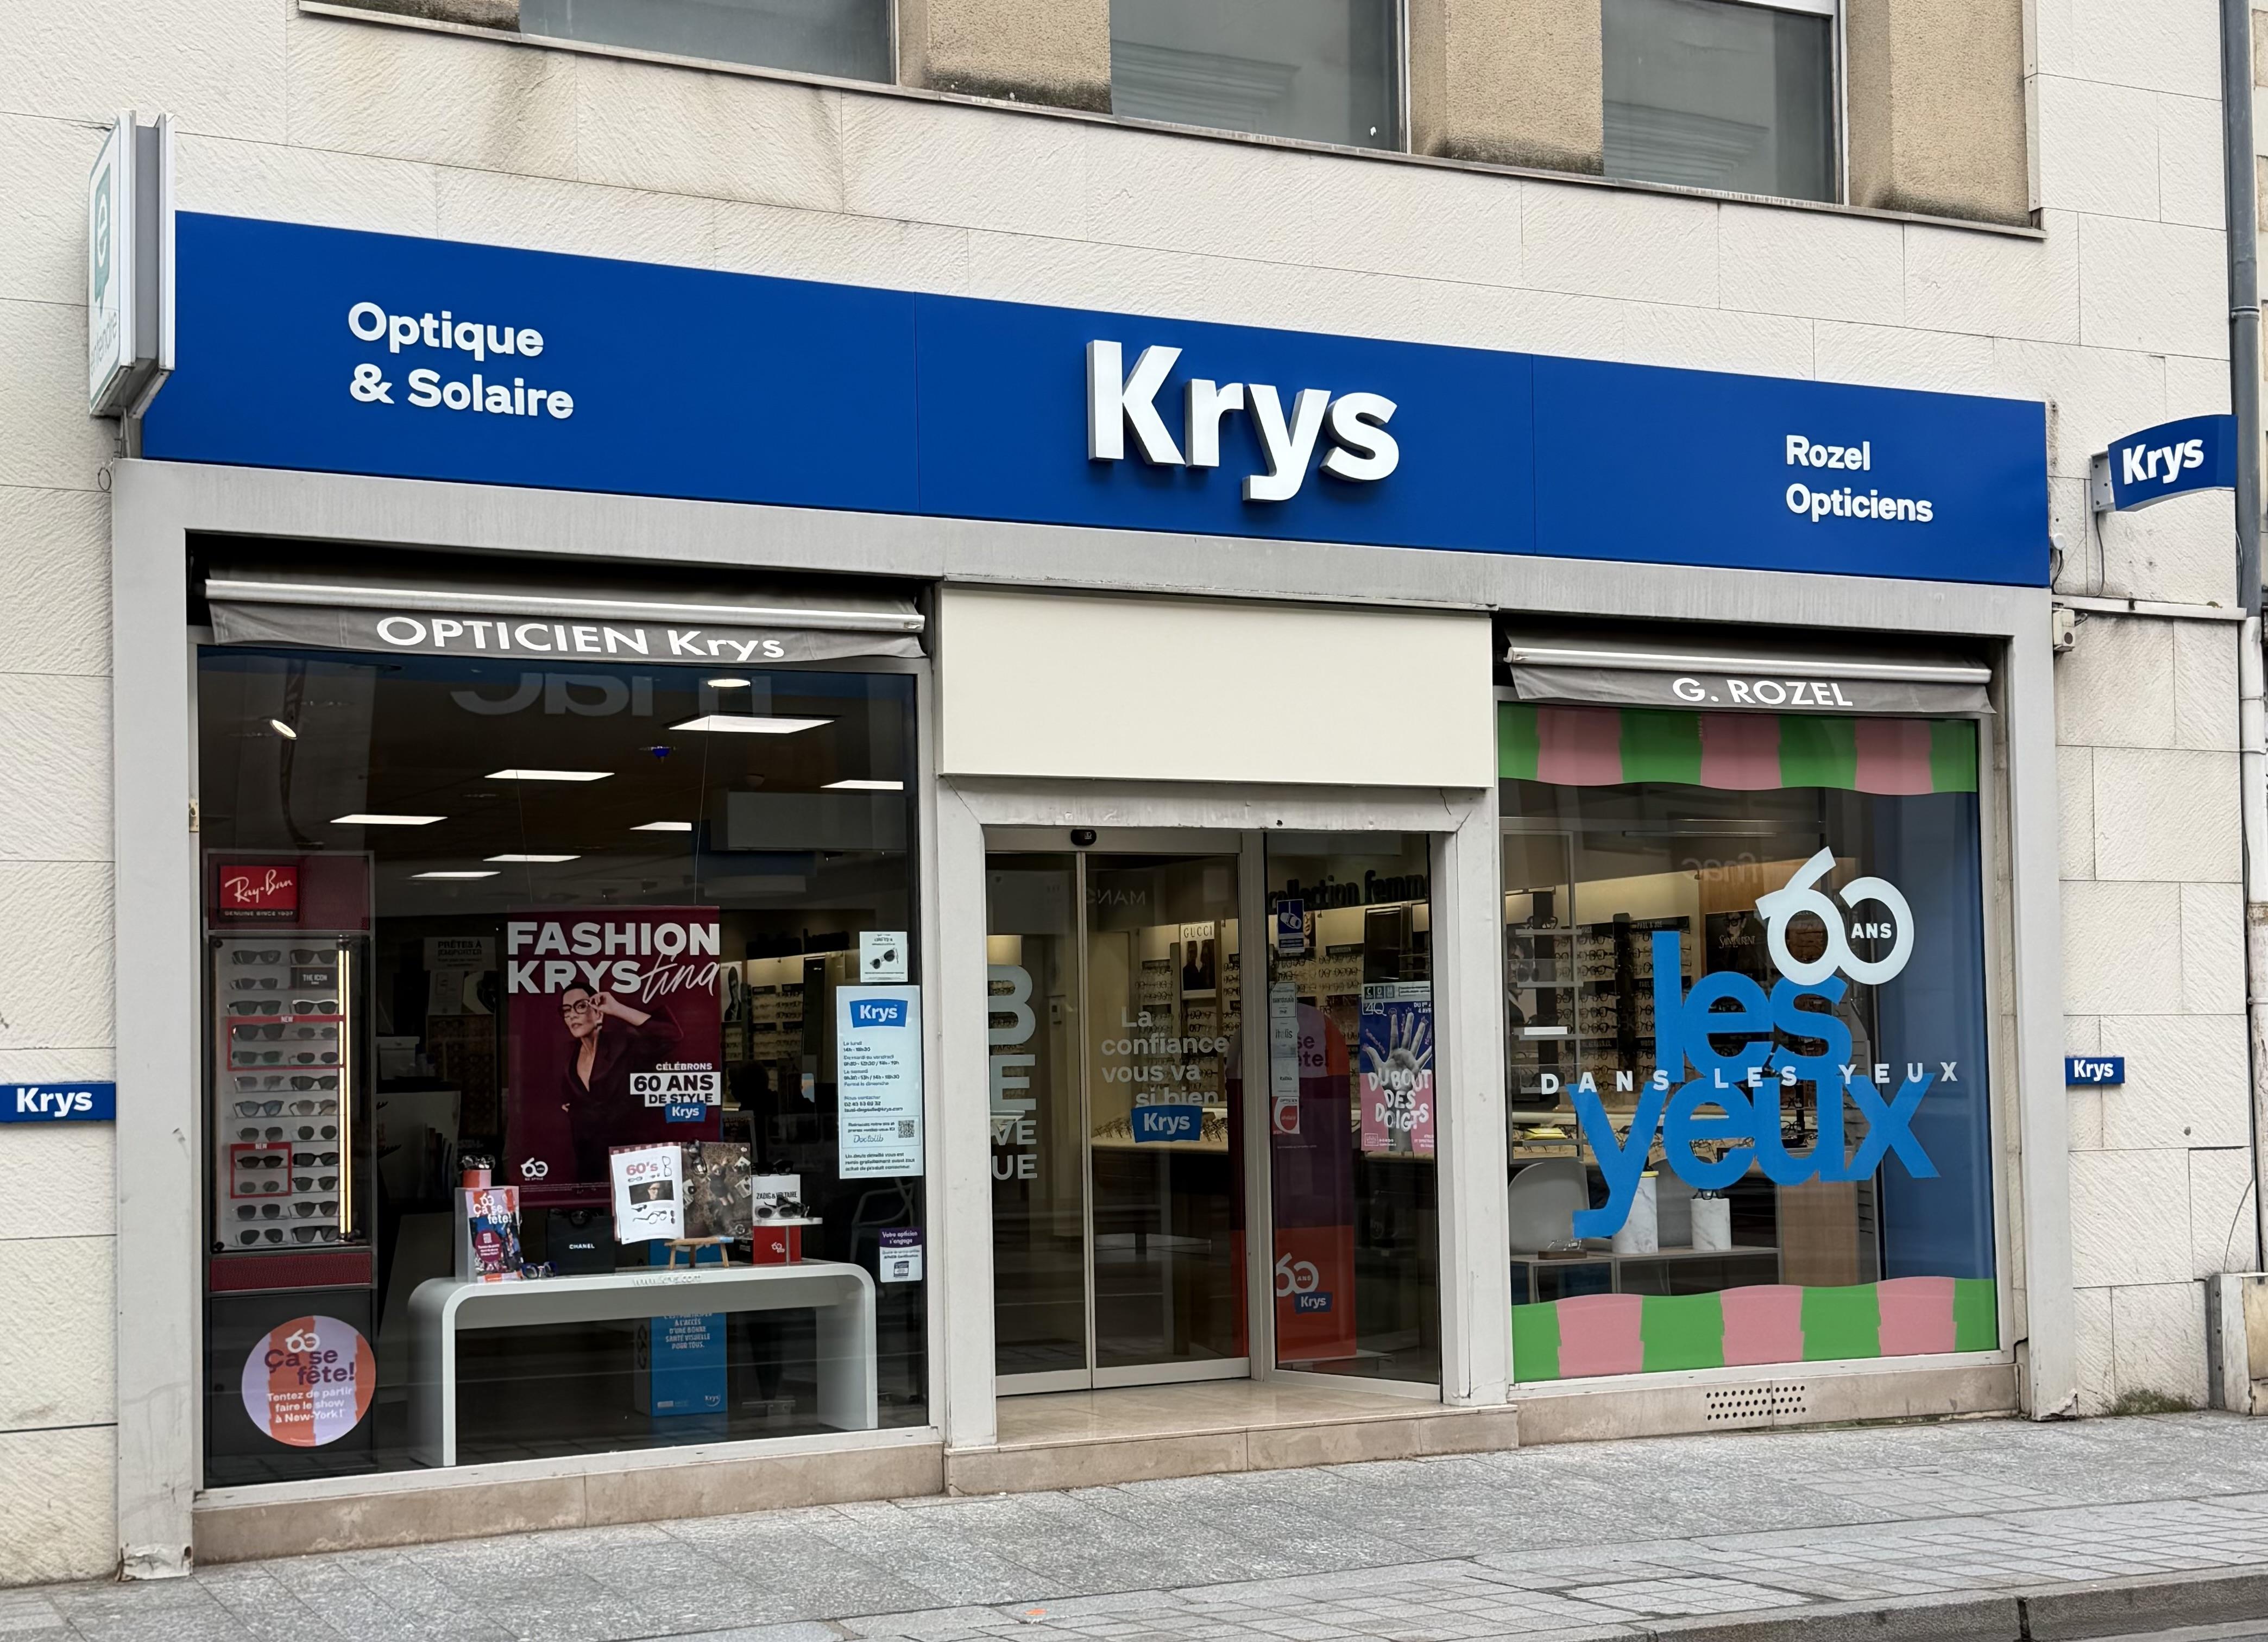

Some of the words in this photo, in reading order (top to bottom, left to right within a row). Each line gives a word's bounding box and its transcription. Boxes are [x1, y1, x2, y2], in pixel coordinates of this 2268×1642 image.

[348, 301, 544, 361] Optique
[349, 363, 395, 405] &
[407, 368, 574, 419] Solaire
[1086, 339, 1400, 501] Krys
[1786, 434, 1870, 471] Rozel
[2122, 438, 2204, 485] Krys
[1785, 483, 1933, 523] Opticiens
[376, 616, 648, 655] OPTICIEN
[666, 629, 785, 661] Krys
[1672, 677, 1719, 703] G.
[1730, 679, 1853, 708] ROZEL
[1365, 870, 1429, 905] femm
[507, 921, 721, 956] FASHION
[1183, 925, 1213, 939] GUCCI
[1850, 923, 1892, 939] ANS
[508, 961, 641, 994] KRYS
[860, 1005, 898, 1022] Krys
[1120, 1006, 1154, 1028] La
[1652, 931, 1853, 1082] les
[1101, 1033, 1230, 1057] confiance
[656, 1062, 713, 1071] CÉLÉBRONS
[1101, 1065, 1164, 1083] vous
[1170, 1065, 1201, 1083] va
[2074, 1059, 2114, 1082] Krys
[634, 1075, 662, 1092] 60
[666, 1075, 714, 1091] ANS
[1541, 1069, 1670, 1095] DANS
[1714, 1065, 1797, 1089] LES
[1838, 1062, 1958, 1084] YEUX
[17, 1088, 93, 1117] Krys
[649, 1094, 667, 1104] DE
[670, 1093, 713, 1104] STYLE
[1135, 1089, 1156, 1107] si
[1163, 1088, 1218, 1107] bien
[1384, 1089, 1416, 1111] DES
[672, 1106, 700, 1119] Krys
[1144, 1112, 1190, 1135] Krys
[1375, 1103, 1429, 1133] DOIGTS
[1566, 1072, 1942, 1239] yeux
[626, 1161, 658, 1176] 60's
[473, 1203, 489, 1218] Ça
[491, 1204, 503, 1216] se
[1300, 1296, 1327, 1309] Krys
[264, 1349, 301, 1374] Ça
[309, 1349, 338, 1365] se
[297, 1361, 355, 1386] fête!
[267, 1392, 304, 1401] Tentez
[306, 1390, 319, 1398] de
[322, 1387, 352, 1400] partir
[275, 1403, 300, 1412] faire
[303, 1401, 312, 1410] le
[315, 1399, 345, 1409] show
[275, 1414, 282, 1423] à
